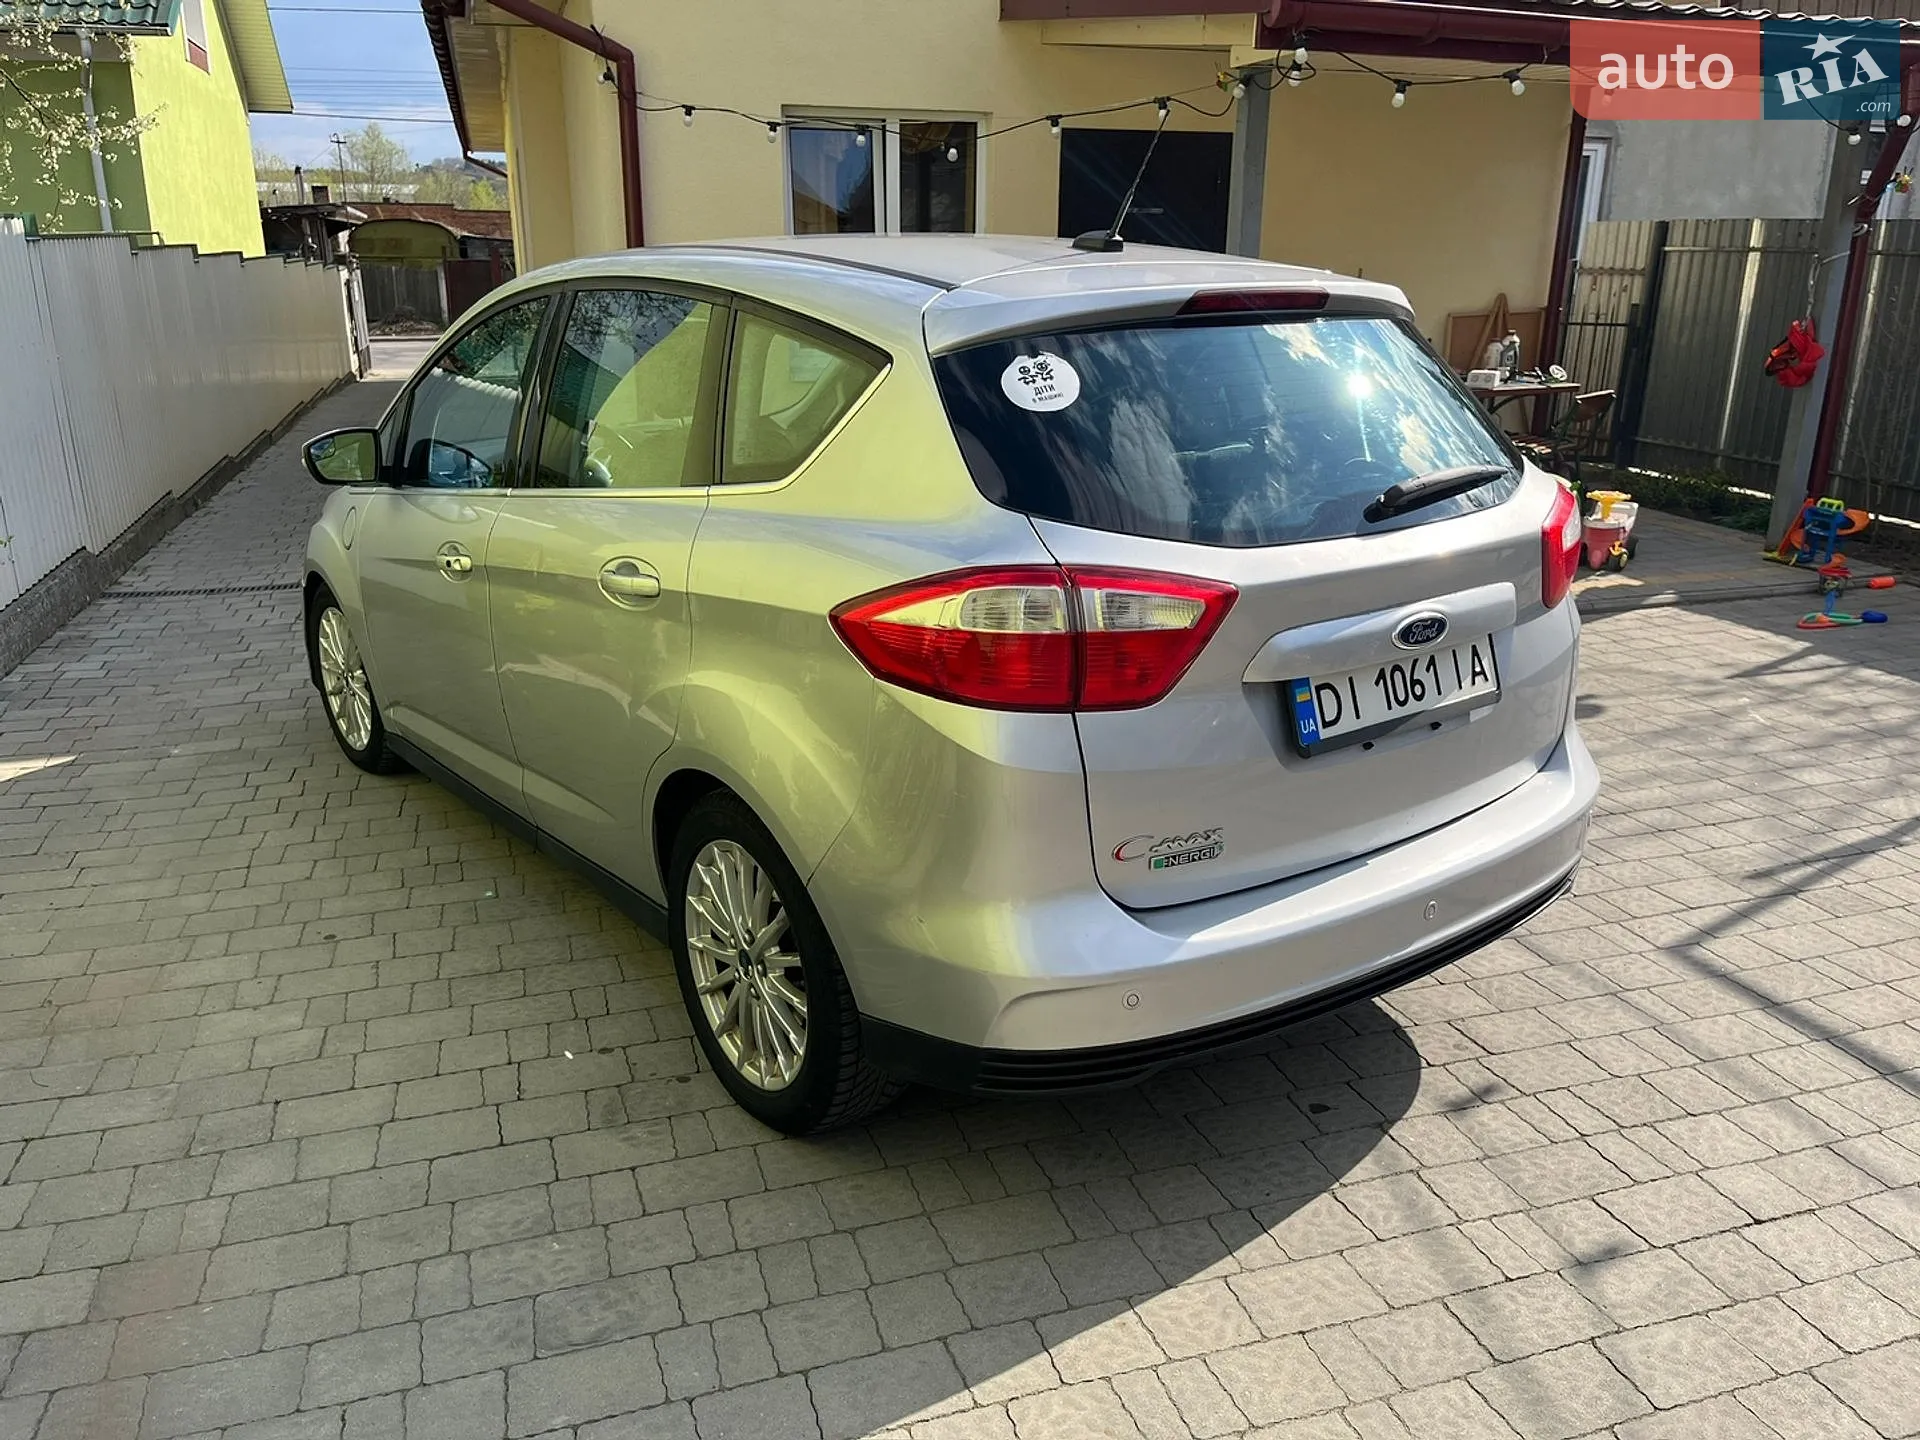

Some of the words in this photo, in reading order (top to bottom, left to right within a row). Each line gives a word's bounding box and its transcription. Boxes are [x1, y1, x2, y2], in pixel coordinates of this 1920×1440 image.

[1408, 620, 1440, 643] Ford
[1315, 676, 1361, 729] DI
[1374, 654, 1443, 711] 1061
[1452, 644, 1489, 690] IA
[1301, 718, 1317, 734] UA
